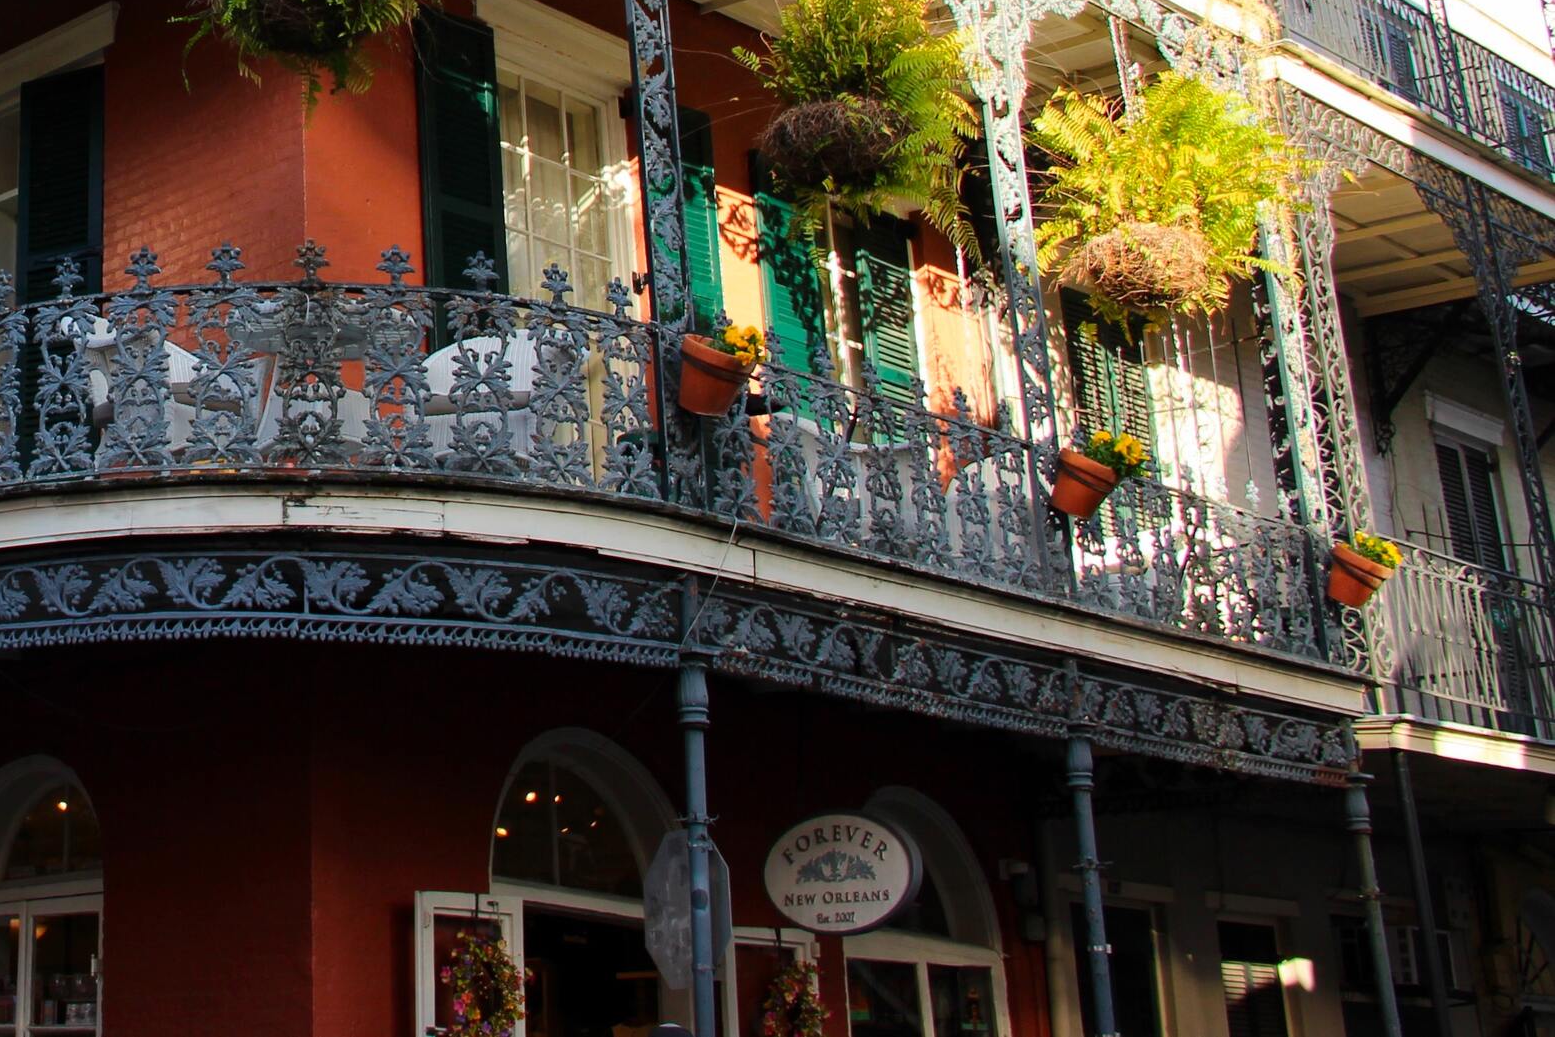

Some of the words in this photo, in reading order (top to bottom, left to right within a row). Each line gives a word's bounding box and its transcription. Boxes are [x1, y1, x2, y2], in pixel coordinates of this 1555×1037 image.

[782, 825, 888, 865] FOREVER
[784, 892, 816, 907] NEW
[822, 889, 890, 905] ORLEANS
